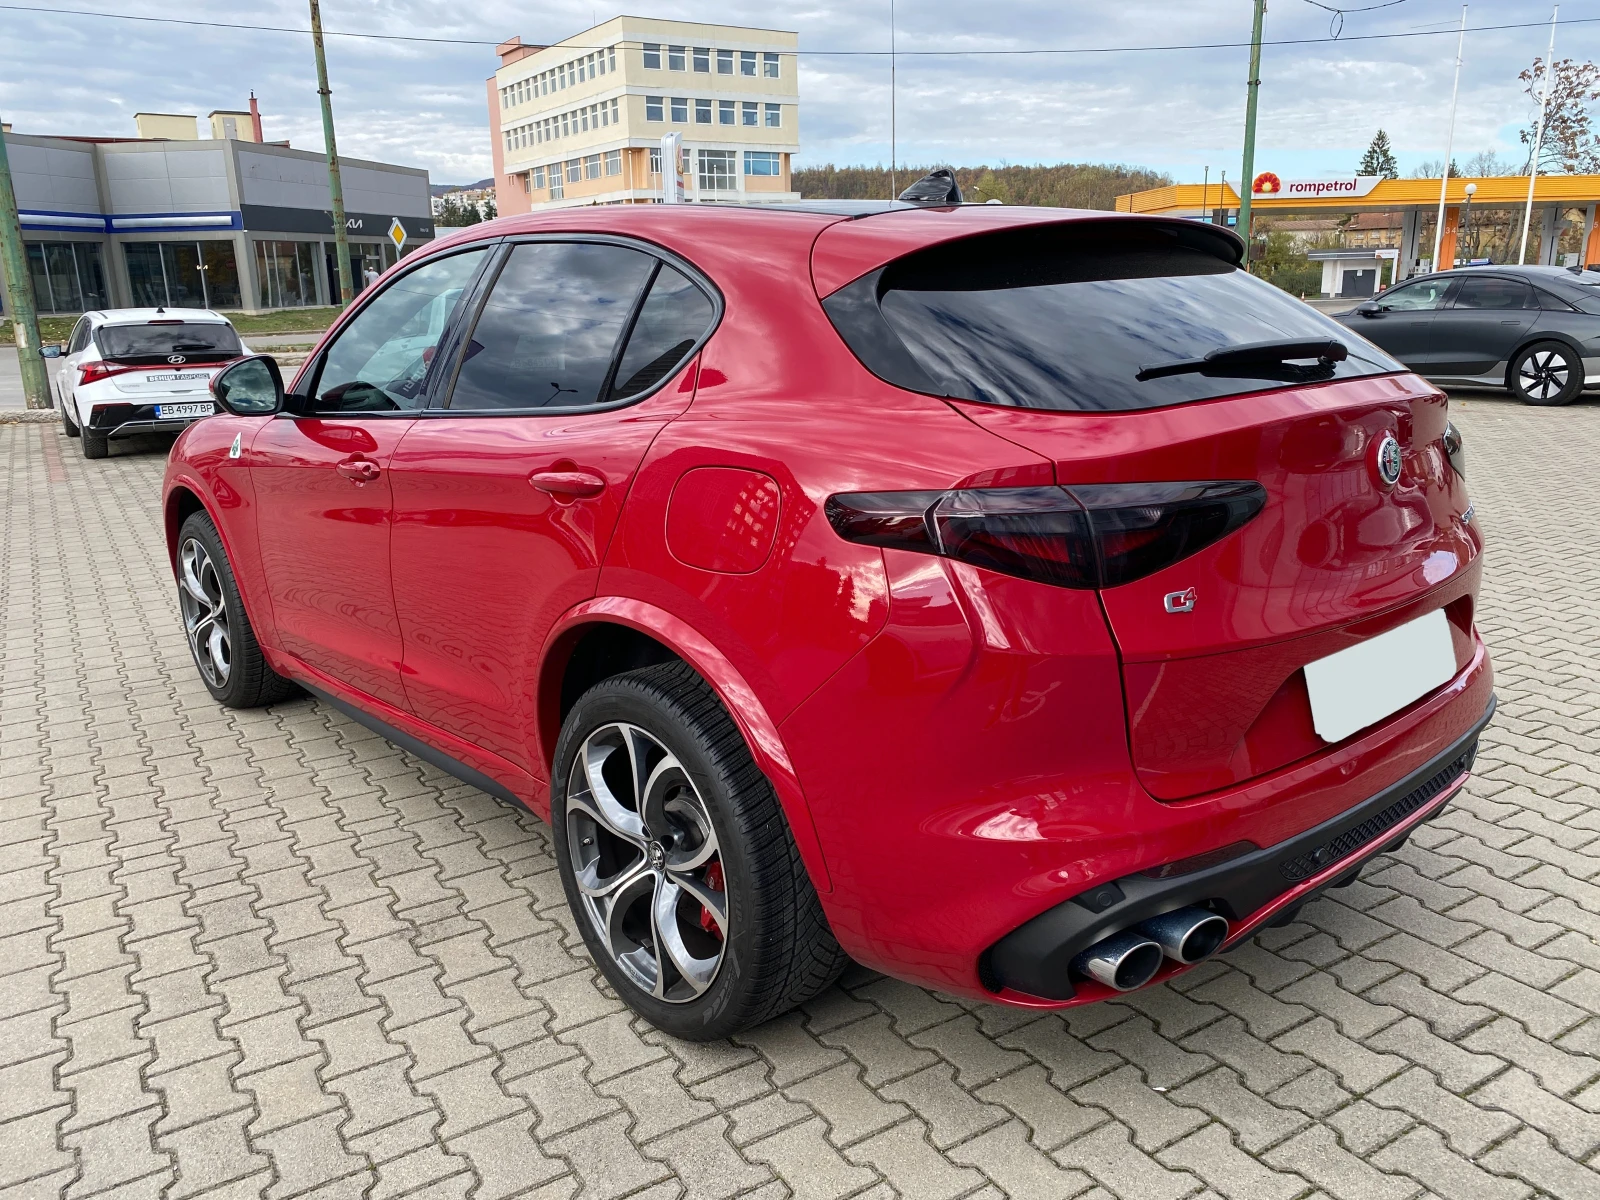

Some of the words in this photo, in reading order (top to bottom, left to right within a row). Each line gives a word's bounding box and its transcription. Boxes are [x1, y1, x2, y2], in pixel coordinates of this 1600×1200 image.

[1289, 178, 1357, 195] rompetrol
[176, 404, 198, 414] 4997
[1163, 586, 1198, 613] Q4
